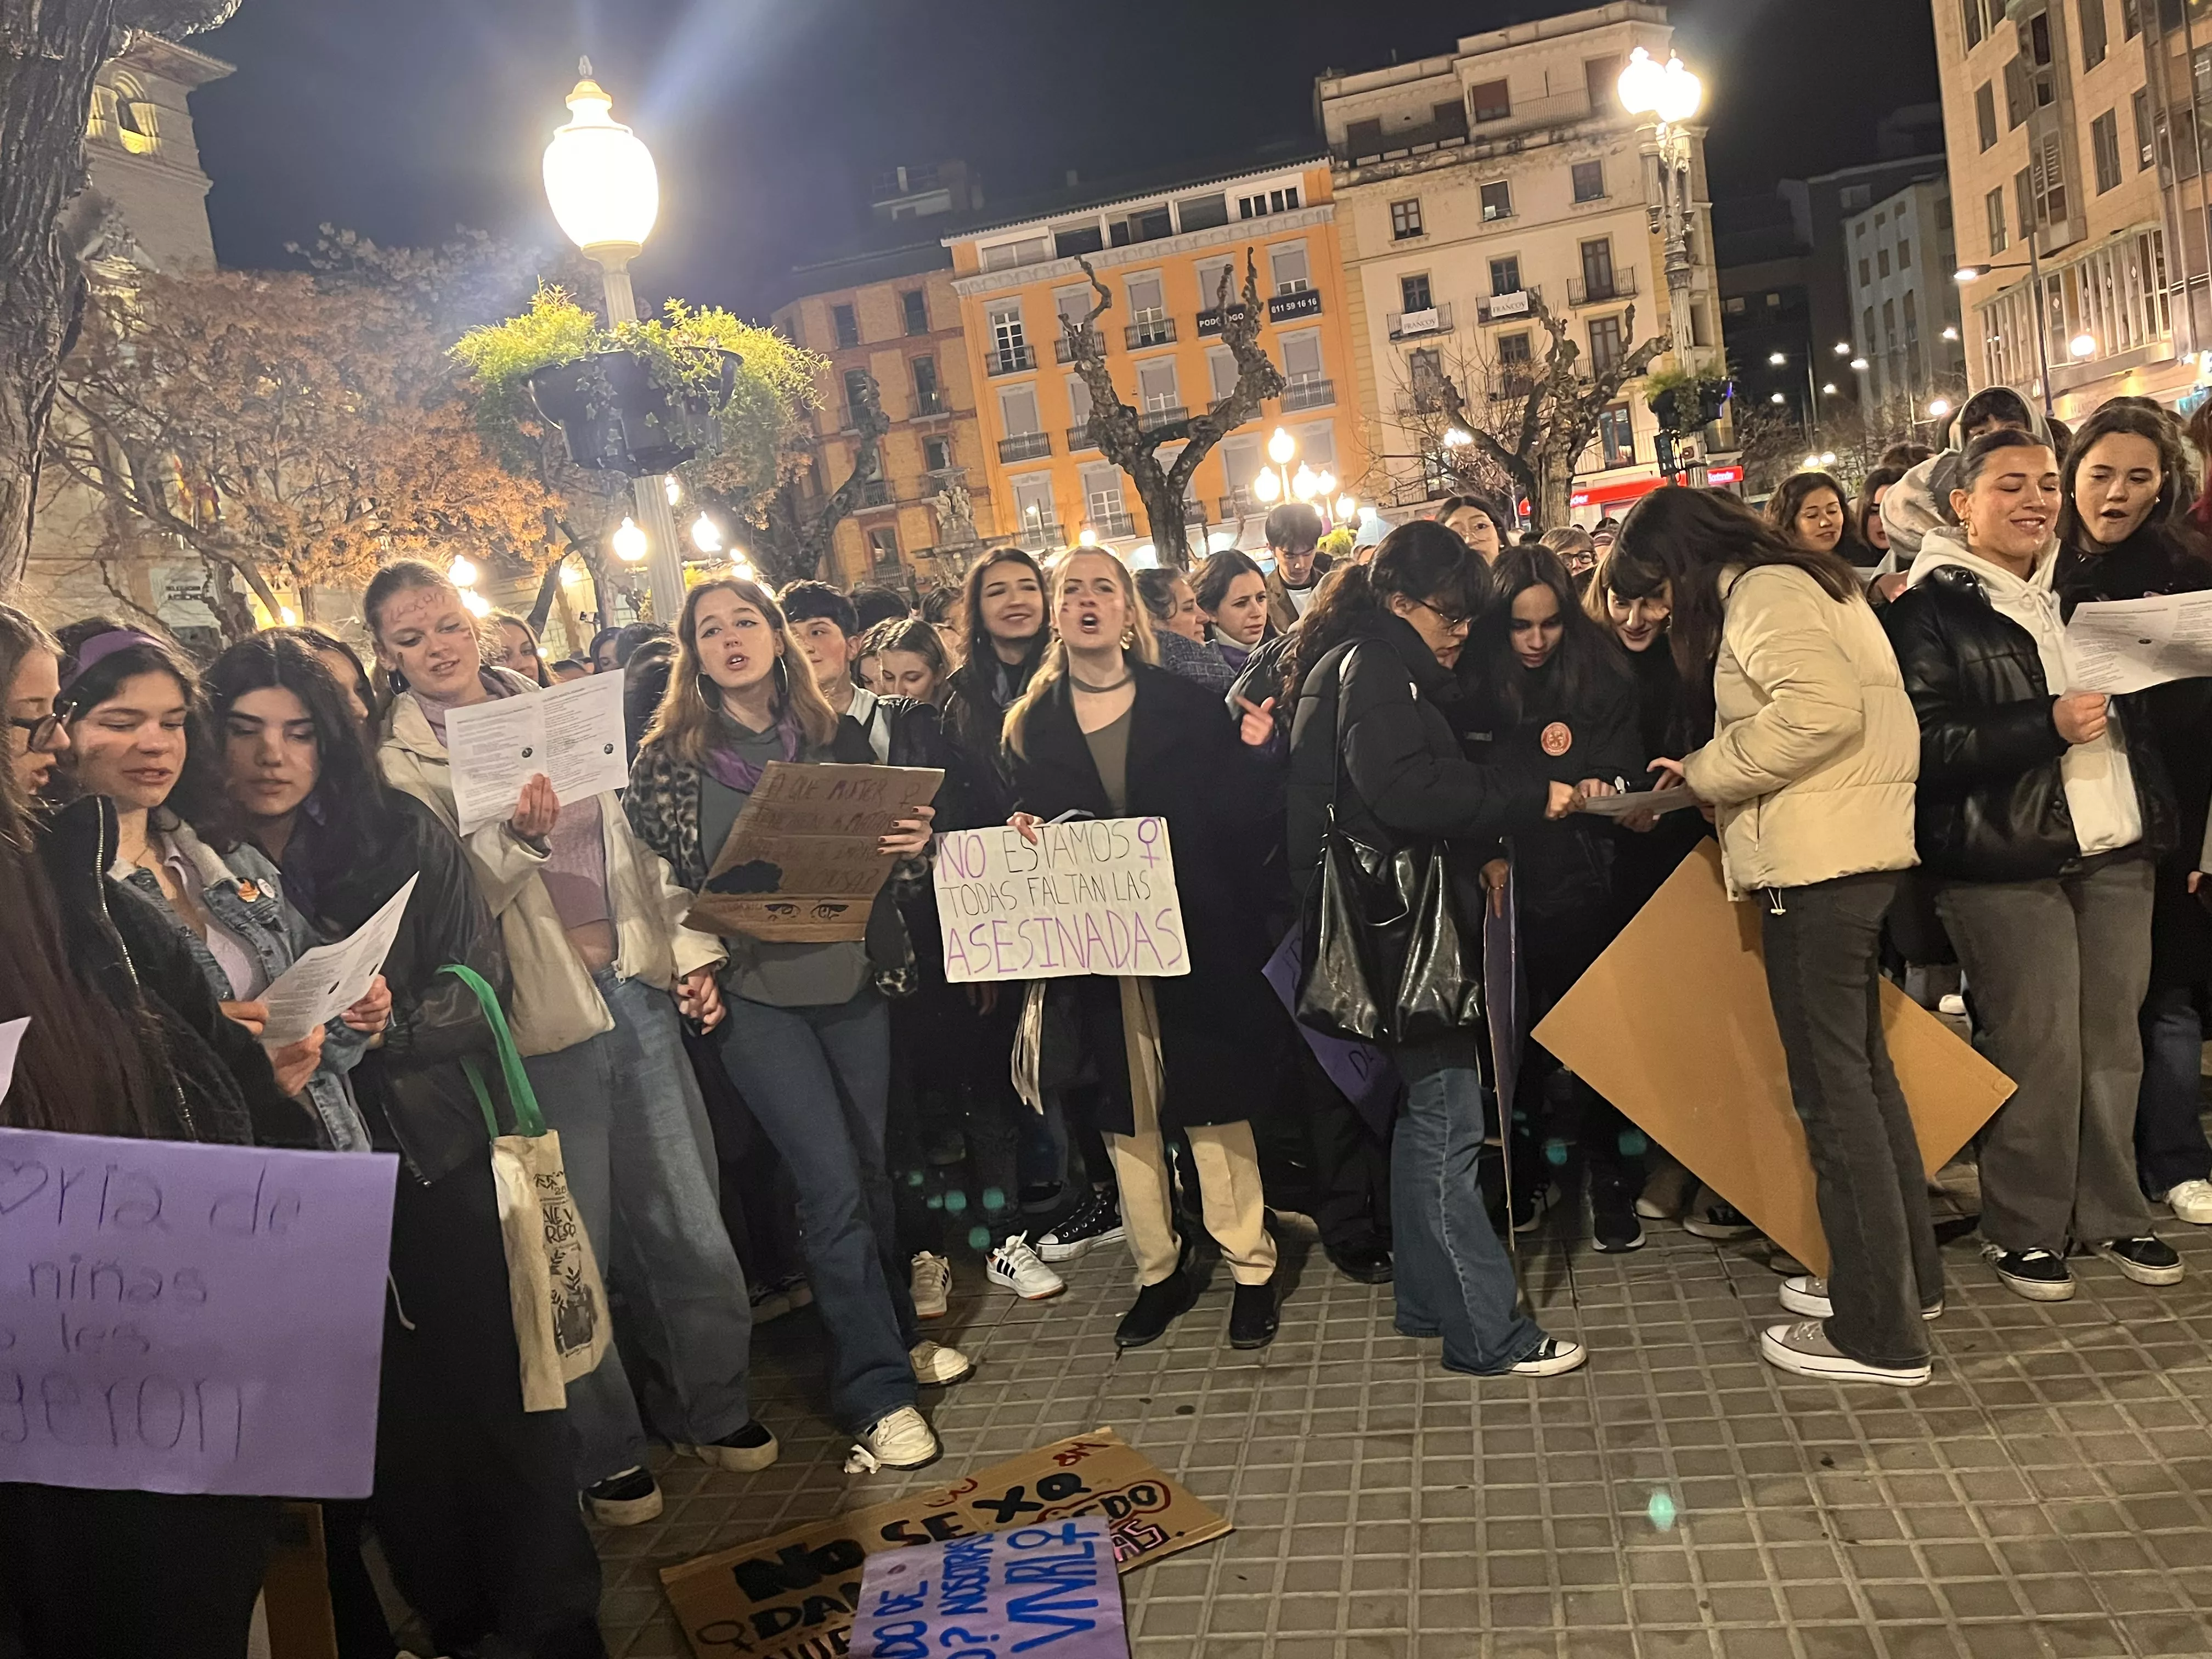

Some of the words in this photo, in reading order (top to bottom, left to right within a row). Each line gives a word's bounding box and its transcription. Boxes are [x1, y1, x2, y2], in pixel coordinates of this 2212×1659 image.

[1286, 302, 1295, 311] 59
[1297, 300, 1306, 308] 16
[1308, 298, 1317, 306] 16
[940, 834, 986, 881] NO
[1002, 820, 1129, 873] ESTAMOS
[940, 881, 1017, 918] TODAS
[1027, 873, 1106, 906] FALTAN
[1113, 870, 1151, 901] LAS
[946, 908, 1182, 977] ASESINADAS
[937, 1533, 994, 1616] NOSOTRAS
